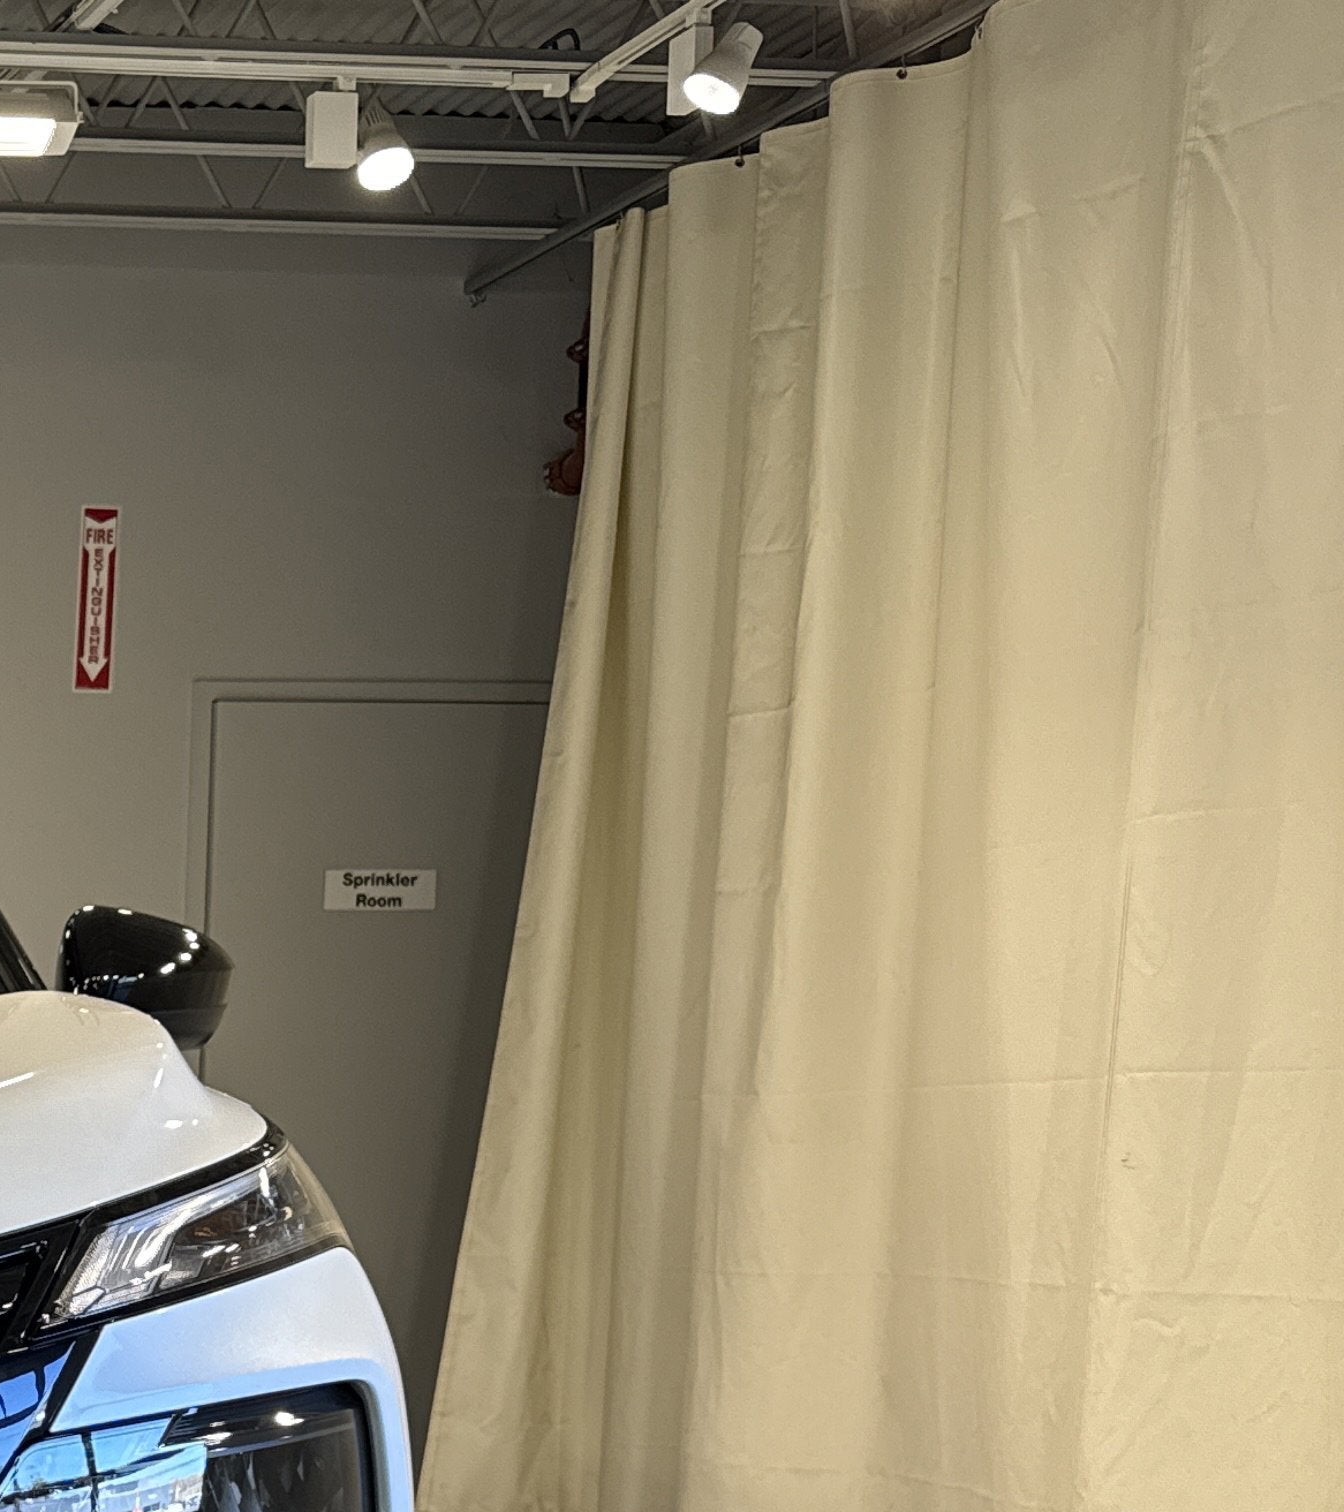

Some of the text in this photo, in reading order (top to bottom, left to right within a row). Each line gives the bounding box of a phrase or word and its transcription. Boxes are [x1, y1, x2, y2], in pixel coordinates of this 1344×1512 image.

[86, 528, 113, 544] FIRE
[88, 548, 104, 664] EXTINGUISHER
[342, 872, 418, 889] Sprinkler
[355, 893, 402, 907] Room
